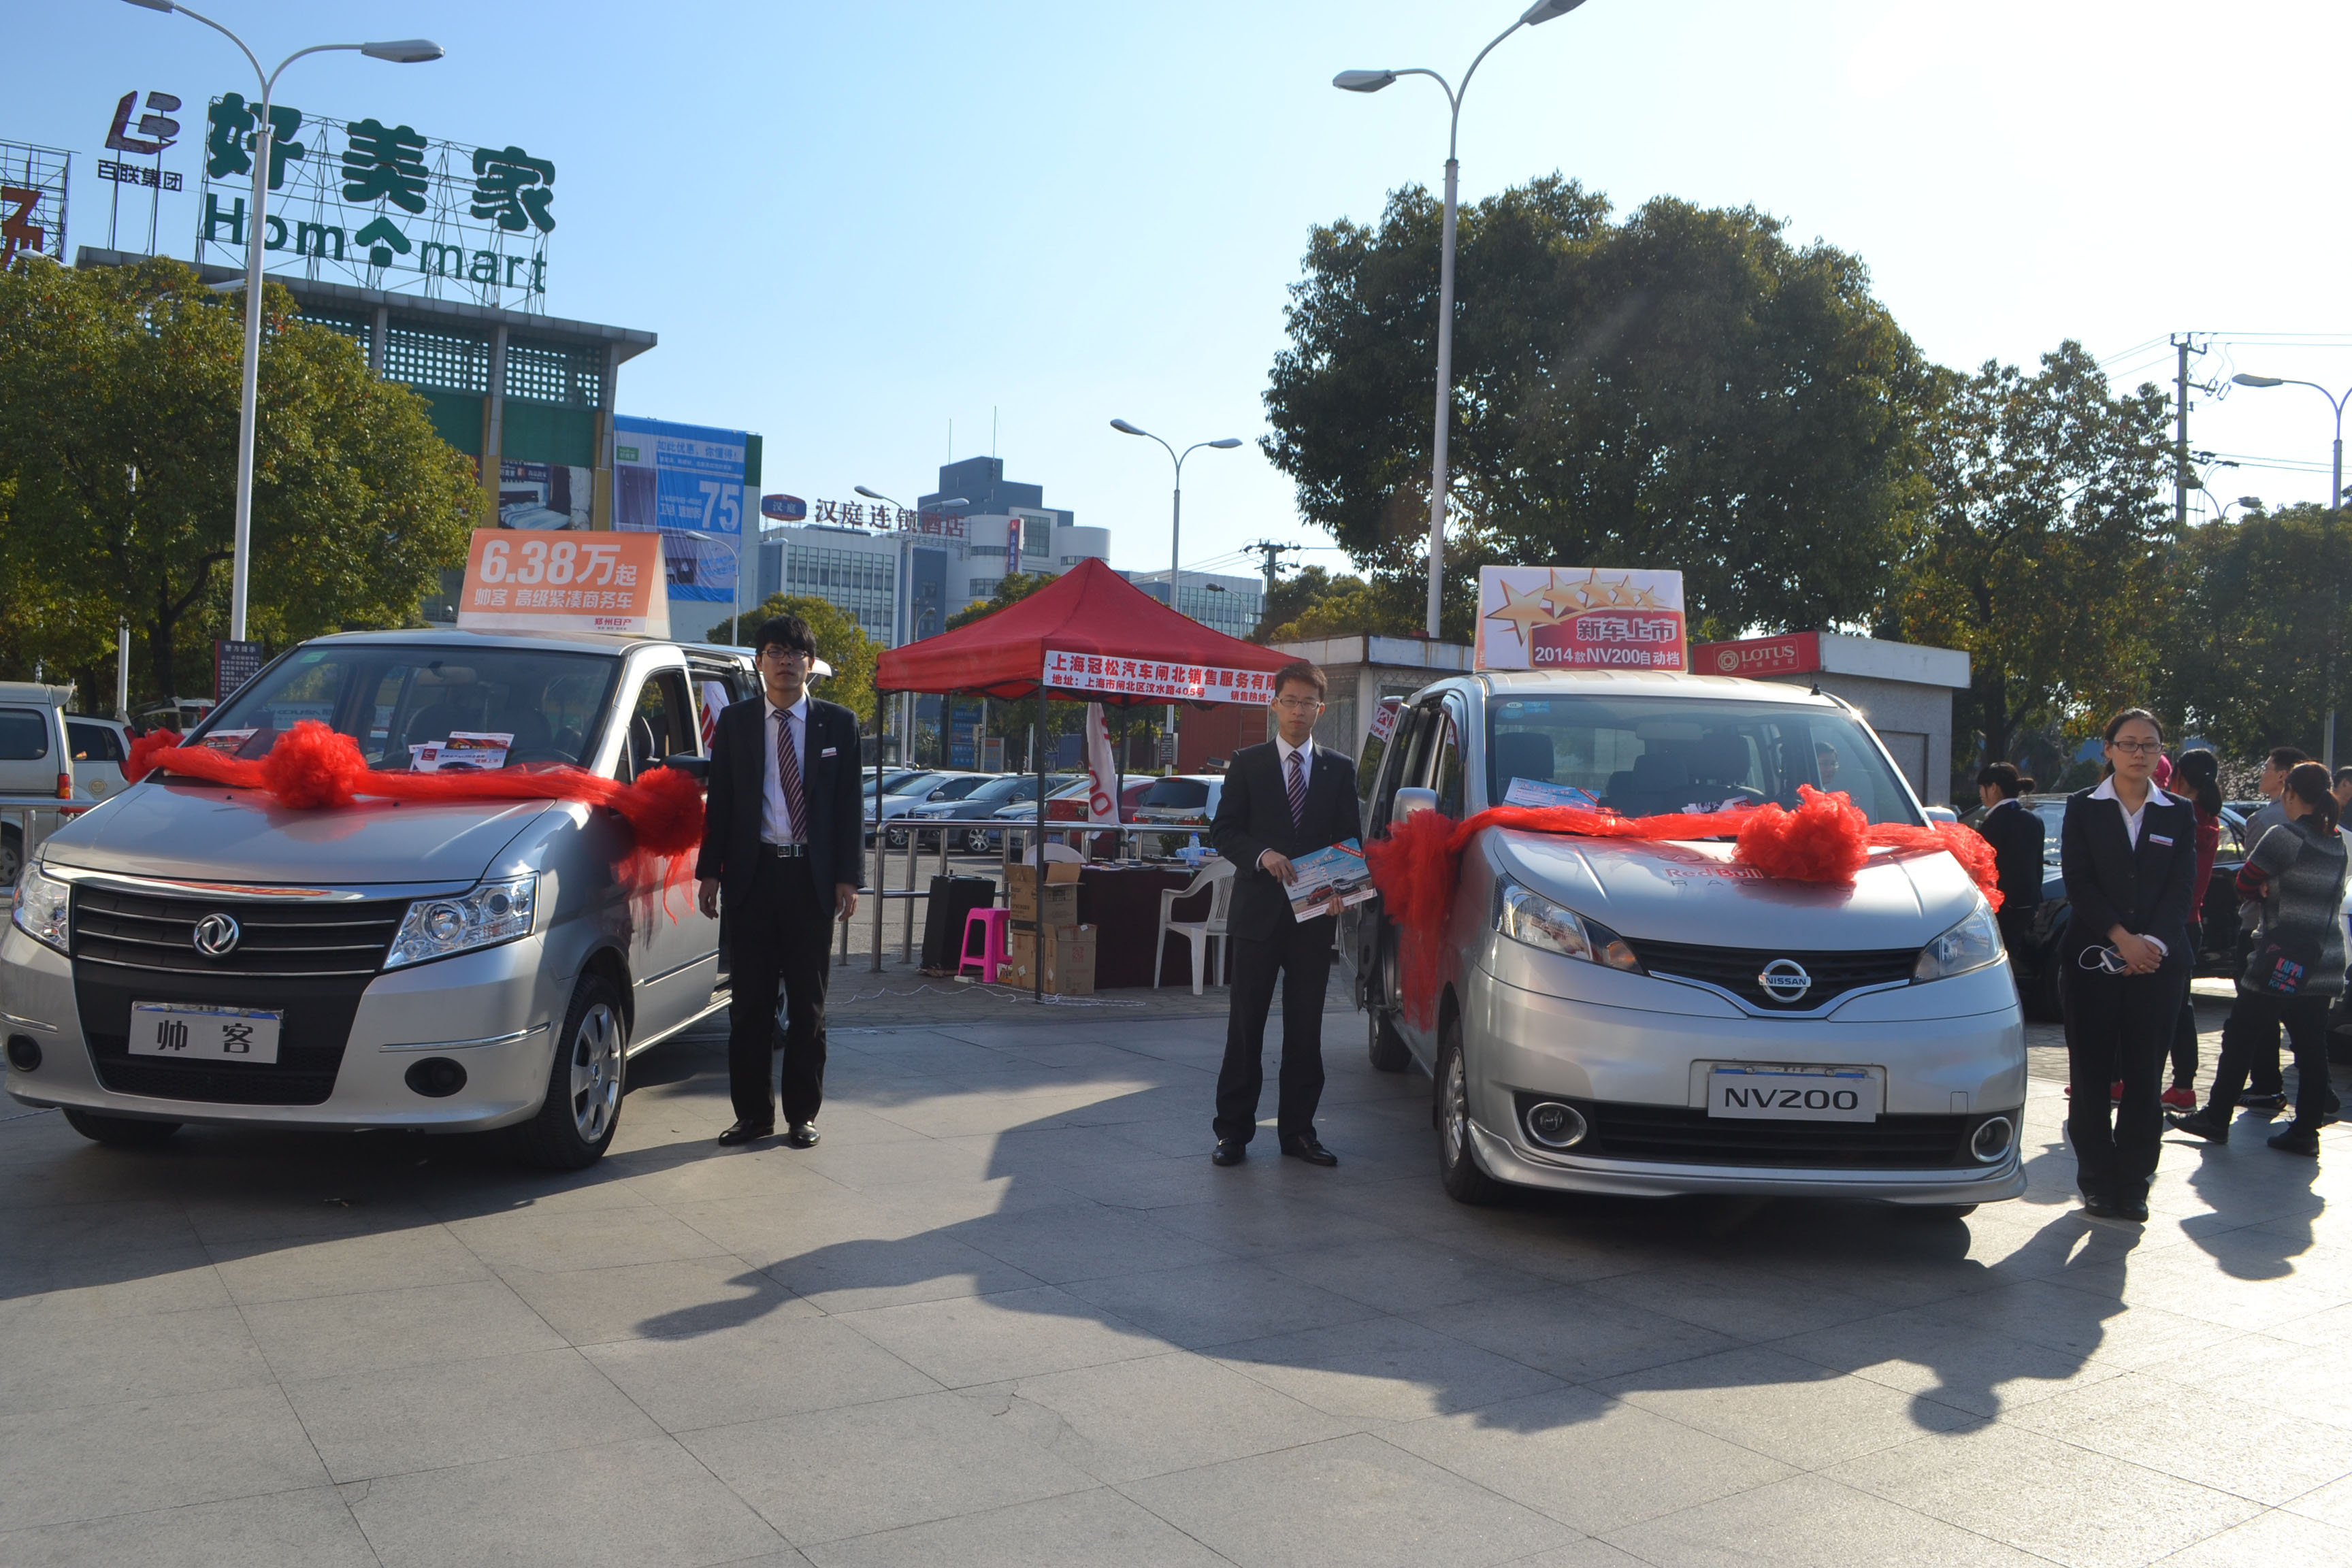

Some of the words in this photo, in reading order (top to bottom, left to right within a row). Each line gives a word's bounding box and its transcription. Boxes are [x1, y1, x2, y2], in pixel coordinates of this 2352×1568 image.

[206, 93, 556, 233] 好美家
[98, 159, 182, 192] 百联集团
[699, 480, 739, 532] 75
[815, 497, 965, 538] 汉庭连锁酒店
[480, 540, 638, 587] 6.38万起
[474, 588, 508, 606] 帅客
[514, 589, 634, 609] 高级紧凑商务车
[595, 617, 632, 626] 郑州日产
[1576, 617, 1678, 643] 新车上市
[1535, 647, 1680, 666] 2014款NV200自动档
[1742, 645, 1795, 662] LOTUS
[1051, 653, 1275, 691] 上海冠松汽车闸北销售服务有限
[1665, 868, 1712, 877] Red
[1714, 868, 1764, 879] Bull
[2276, 957, 2304, 979] KAPPA
[1766, 977, 1807, 986] NISSAN
[1725, 1087, 1859, 1111] NV200
